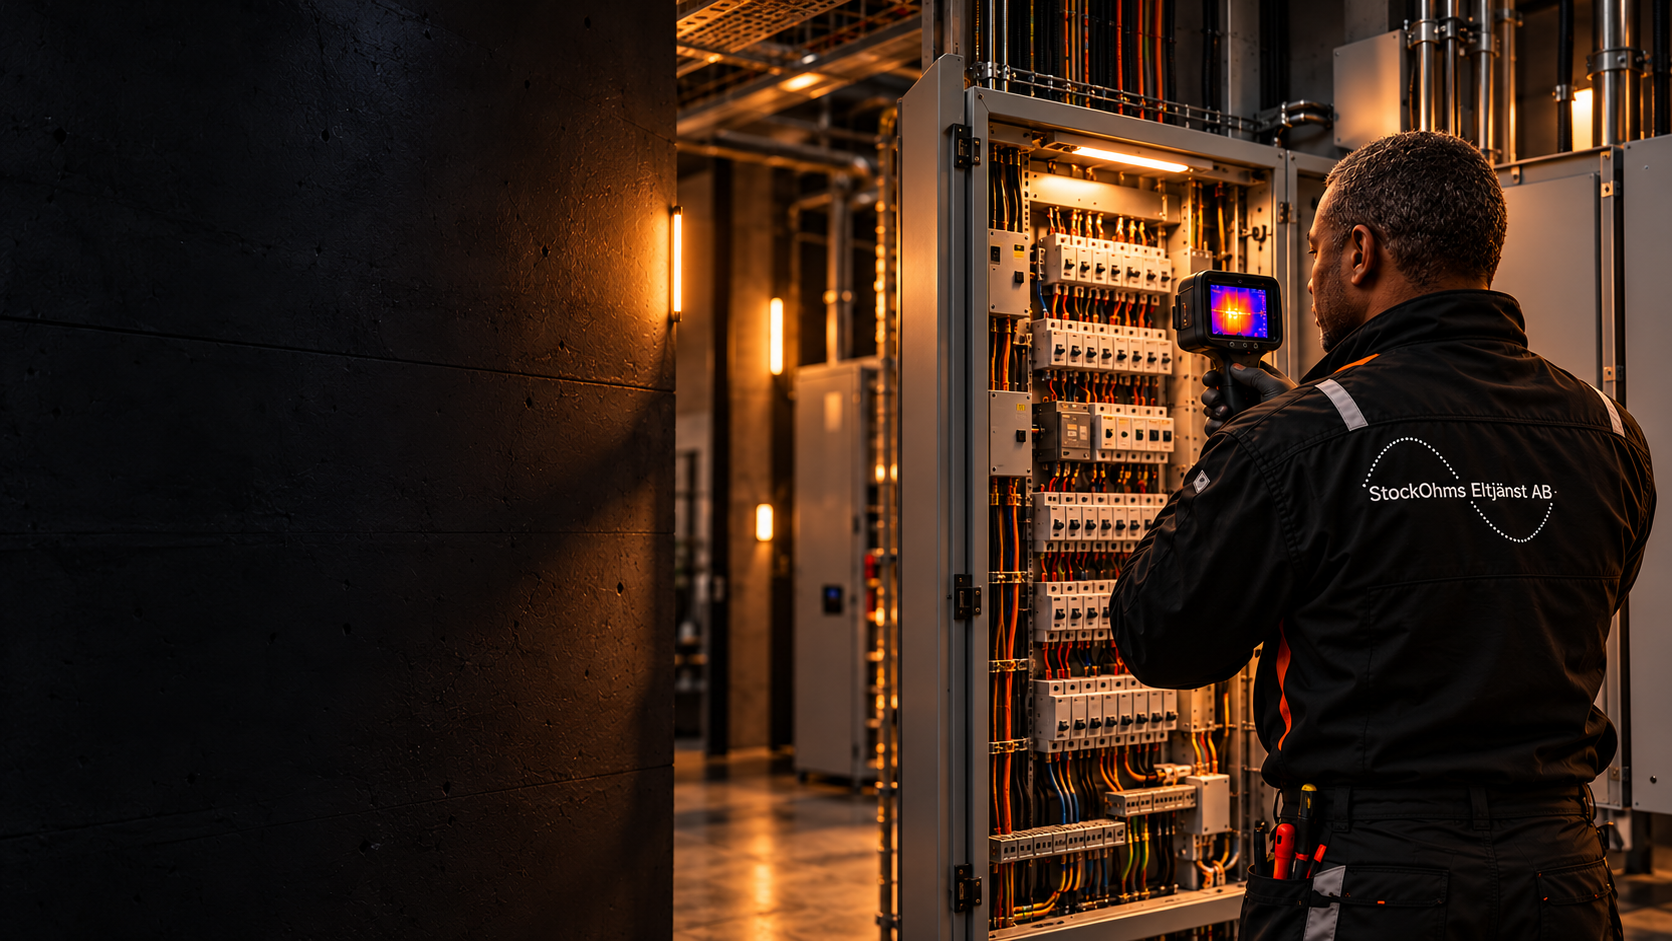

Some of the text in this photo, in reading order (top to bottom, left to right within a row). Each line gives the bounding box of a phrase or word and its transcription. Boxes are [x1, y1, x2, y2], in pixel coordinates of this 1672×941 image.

[1368, 481, 1553, 502] StockOhms Eltjänst AB
